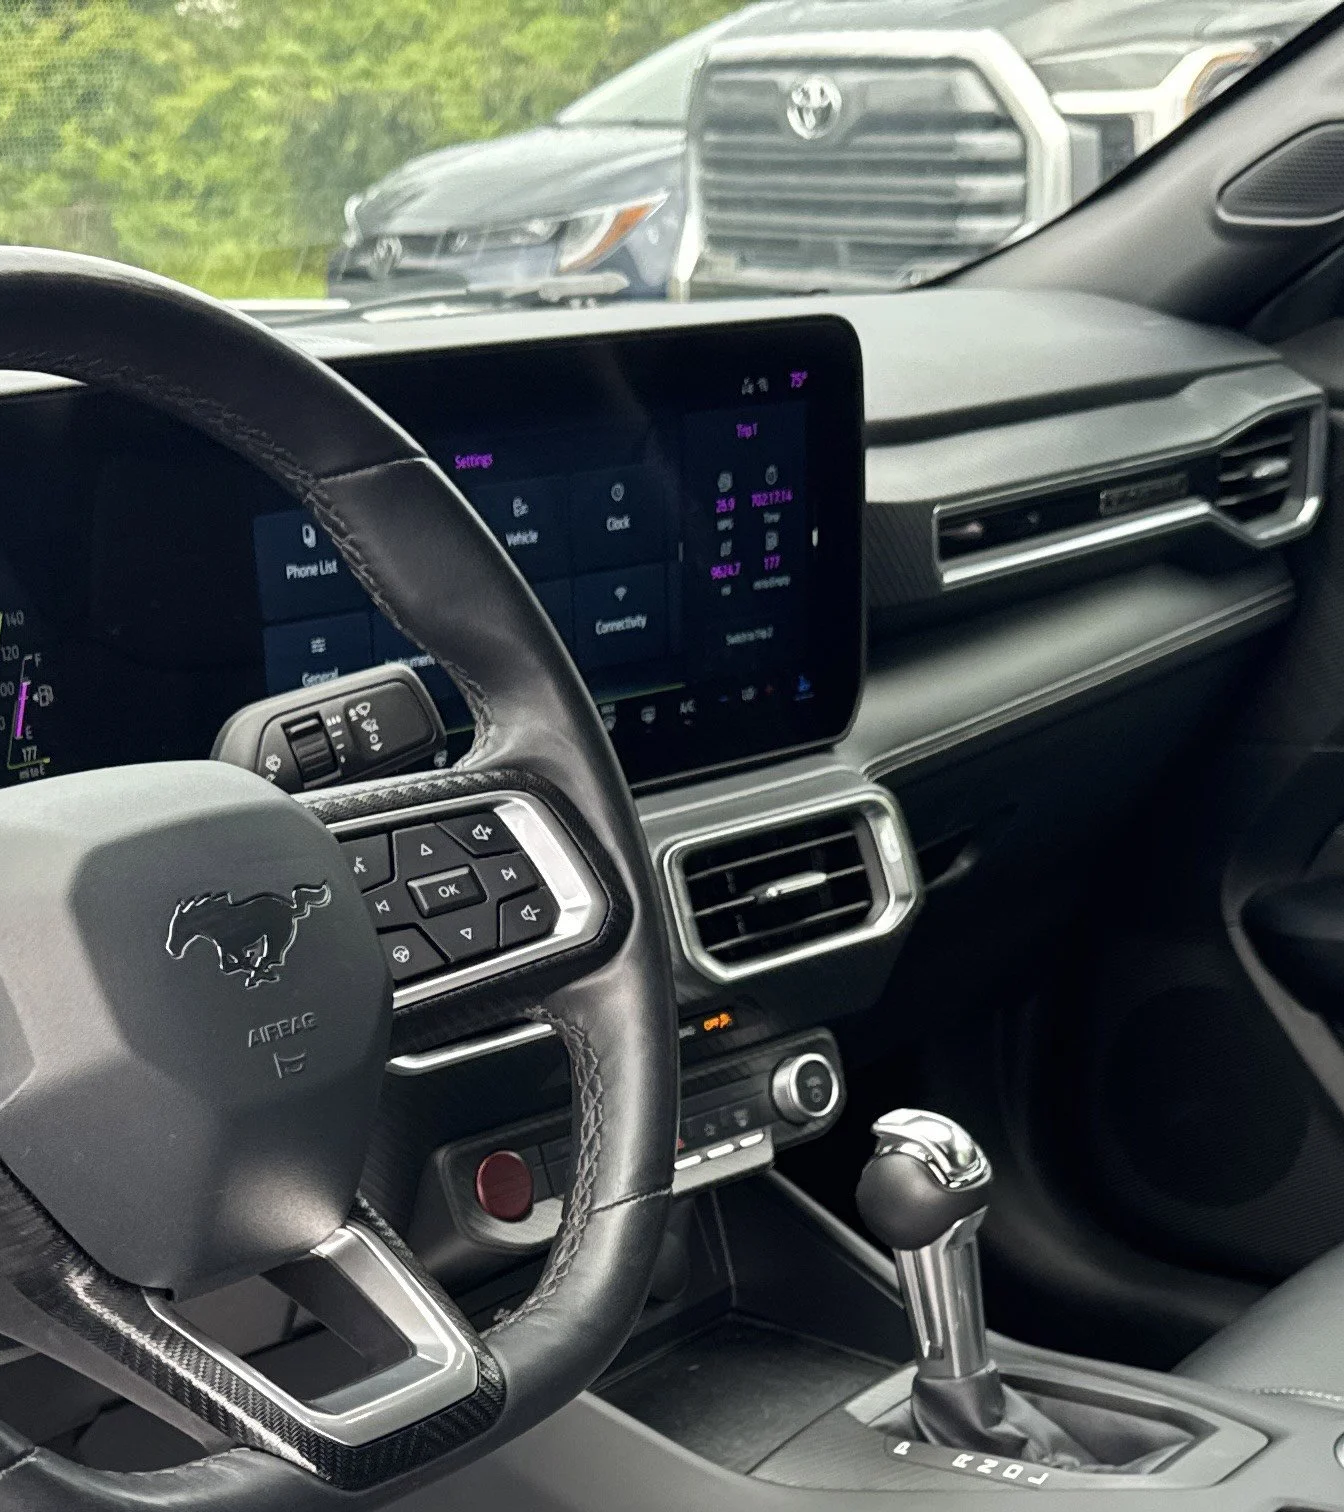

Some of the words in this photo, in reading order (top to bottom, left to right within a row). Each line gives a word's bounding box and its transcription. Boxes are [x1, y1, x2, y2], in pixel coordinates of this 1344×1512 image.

[285, 563, 318, 580] Phone
[319, 559, 339, 576] List
[6, 610, 25, 627] 140
[595, 614, 647, 635] Connectivity
[1, 645, 20, 662] 120
[438, 882, 460, 899] OK
[247, 1010, 319, 1048] AIRBAG
[893, 1441, 911, 1455] P
[952, 1453, 974, 1468] R
[1002, 1463, 1024, 1480] D
[1027, 1472, 1049, 1485] L
